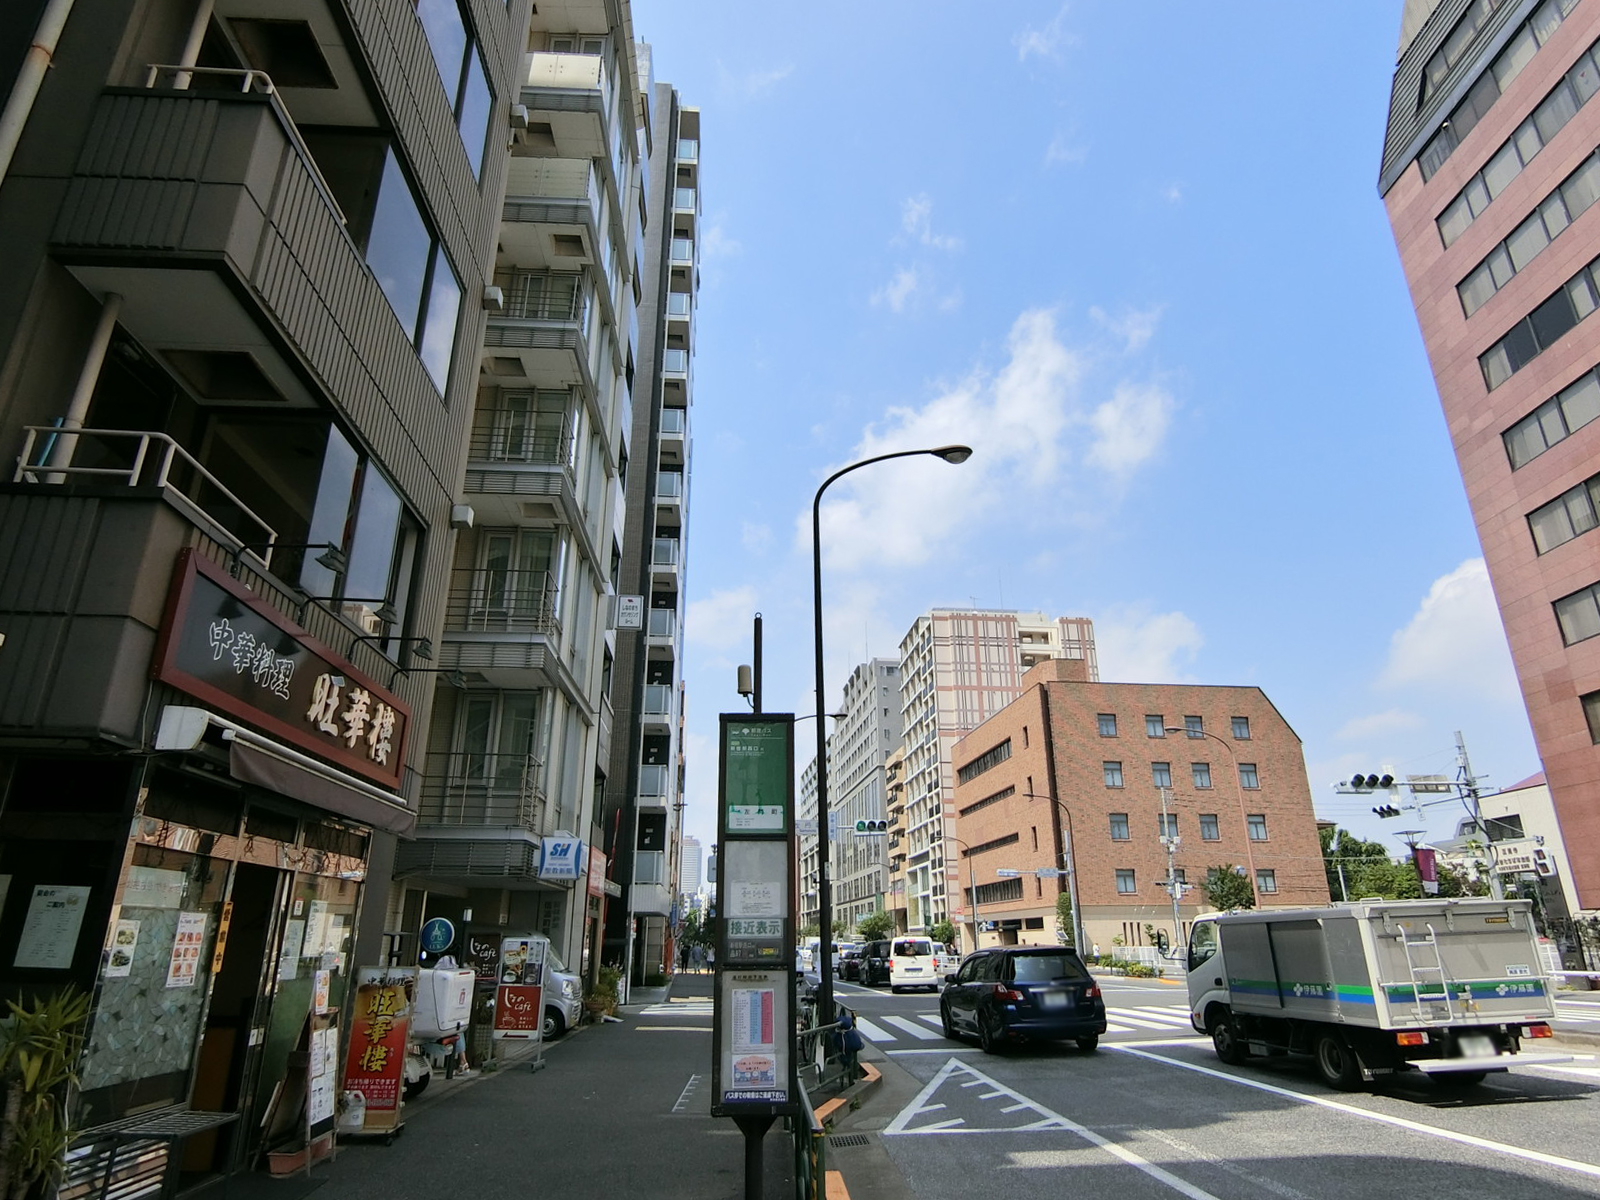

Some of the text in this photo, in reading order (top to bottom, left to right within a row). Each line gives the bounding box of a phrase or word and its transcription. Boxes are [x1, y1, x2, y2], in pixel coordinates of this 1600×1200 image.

[209, 618, 295, 700] 中華料理
[730, 920, 780, 935] 接近表示
[1304, 985, 1323, 996] 伊藤園
[1510, 983, 1534, 994] 伊藤園
